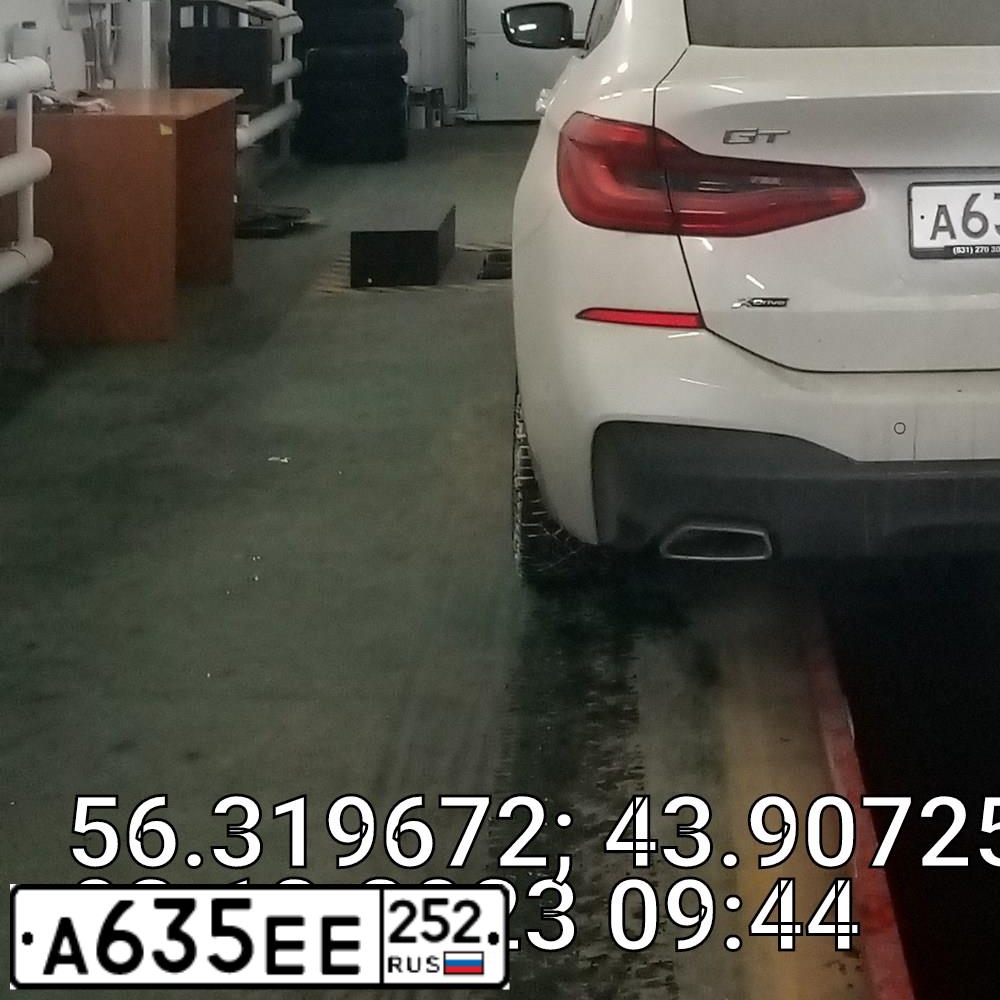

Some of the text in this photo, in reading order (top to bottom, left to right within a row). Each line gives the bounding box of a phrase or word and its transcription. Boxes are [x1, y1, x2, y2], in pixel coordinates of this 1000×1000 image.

[722, 128, 791, 144] GT
[952, 245, 974, 255] (831)
[974, 245, 990, 254] 270
